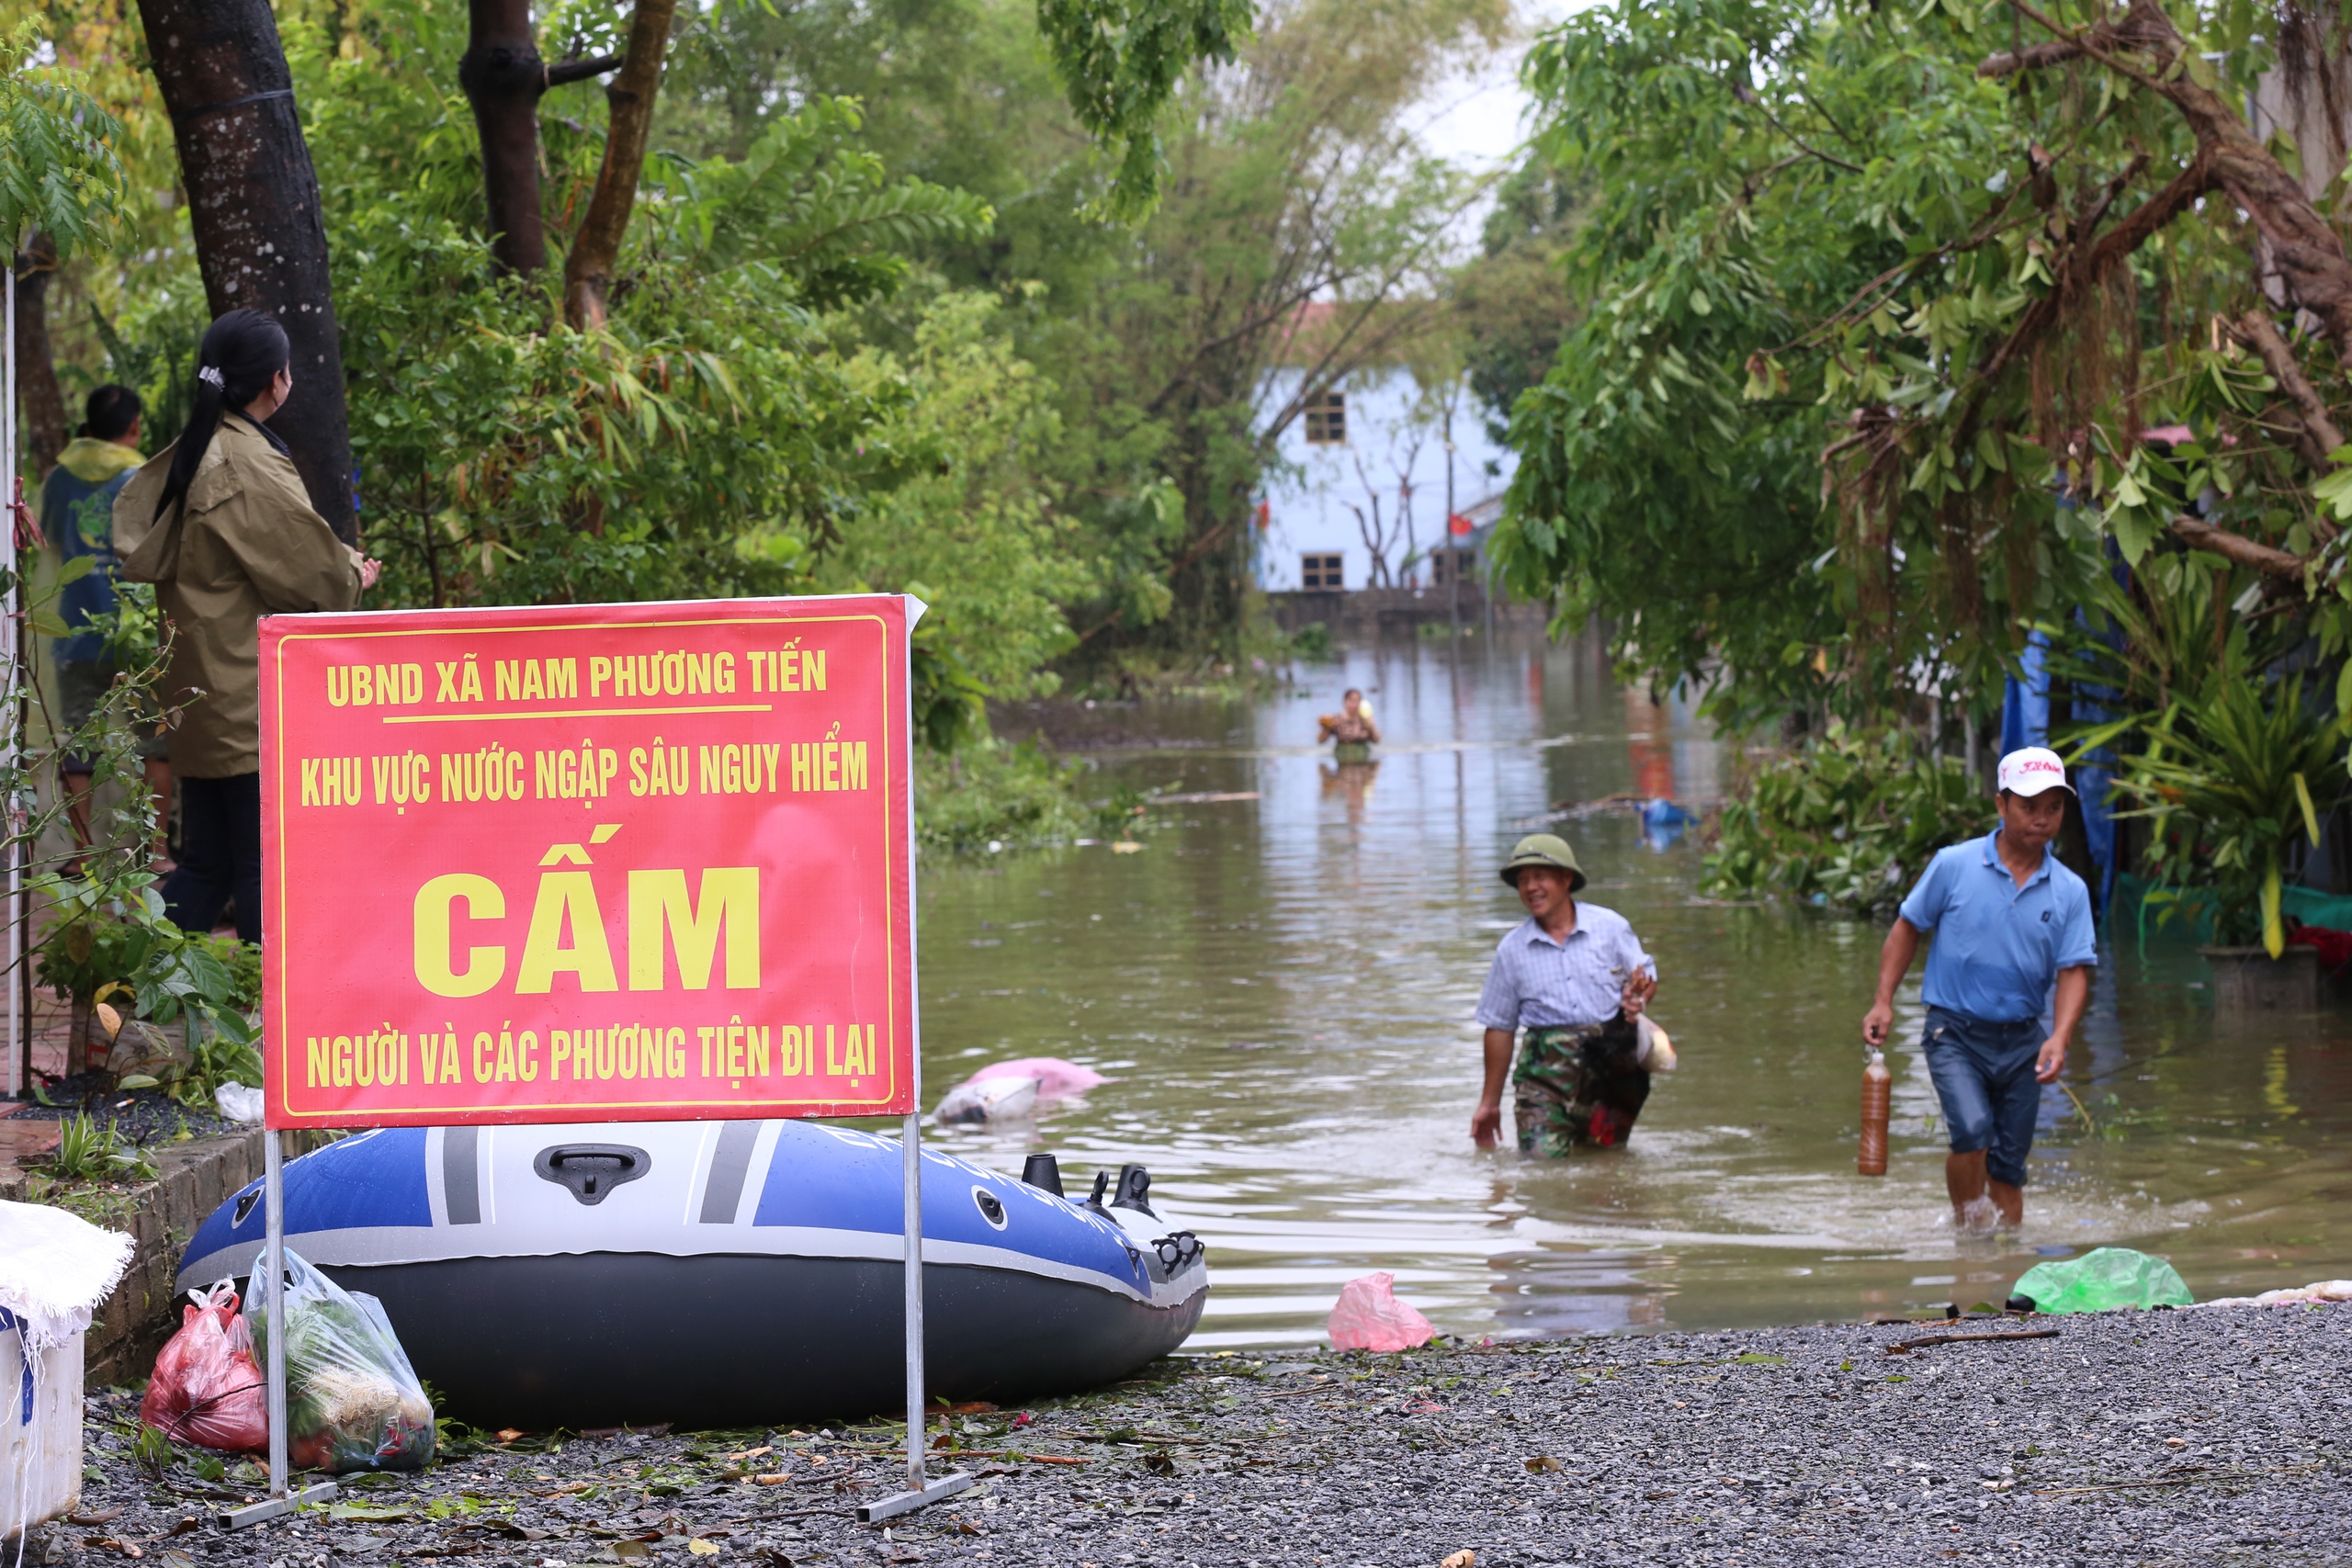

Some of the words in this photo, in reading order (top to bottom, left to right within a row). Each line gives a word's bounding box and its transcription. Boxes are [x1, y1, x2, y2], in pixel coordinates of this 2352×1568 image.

[327, 663, 424, 705] UBND
[435, 652, 483, 702] XÃ
[494, 658, 578, 701] NAM
[589, 650, 736, 698] PHƯƠNG
[746, 637, 827, 693] TIẾN
[300, 756, 362, 807] KHU
[372, 750, 431, 815] VỰC
[441, 741, 525, 802] NƯỚC
[535, 738, 618, 809] NGẬP
[629, 736, 690, 796] SÂU
[699, 743, 780, 795] NGUY
[791, 721, 868, 793] HIỂM
[413, 824, 761, 998] CẤM
[307, 1021, 408, 1088] NGƯỜI
[420, 1022, 461, 1084] VÀ
[473, 1021, 538, 1083] CÁC
[550, 1022, 686, 1082] PHƯƠNG
[697, 1015, 770, 1089] TIỆN
[781, 1025, 814, 1077] ĐI
[826, 1024, 876, 1088] LẠI
